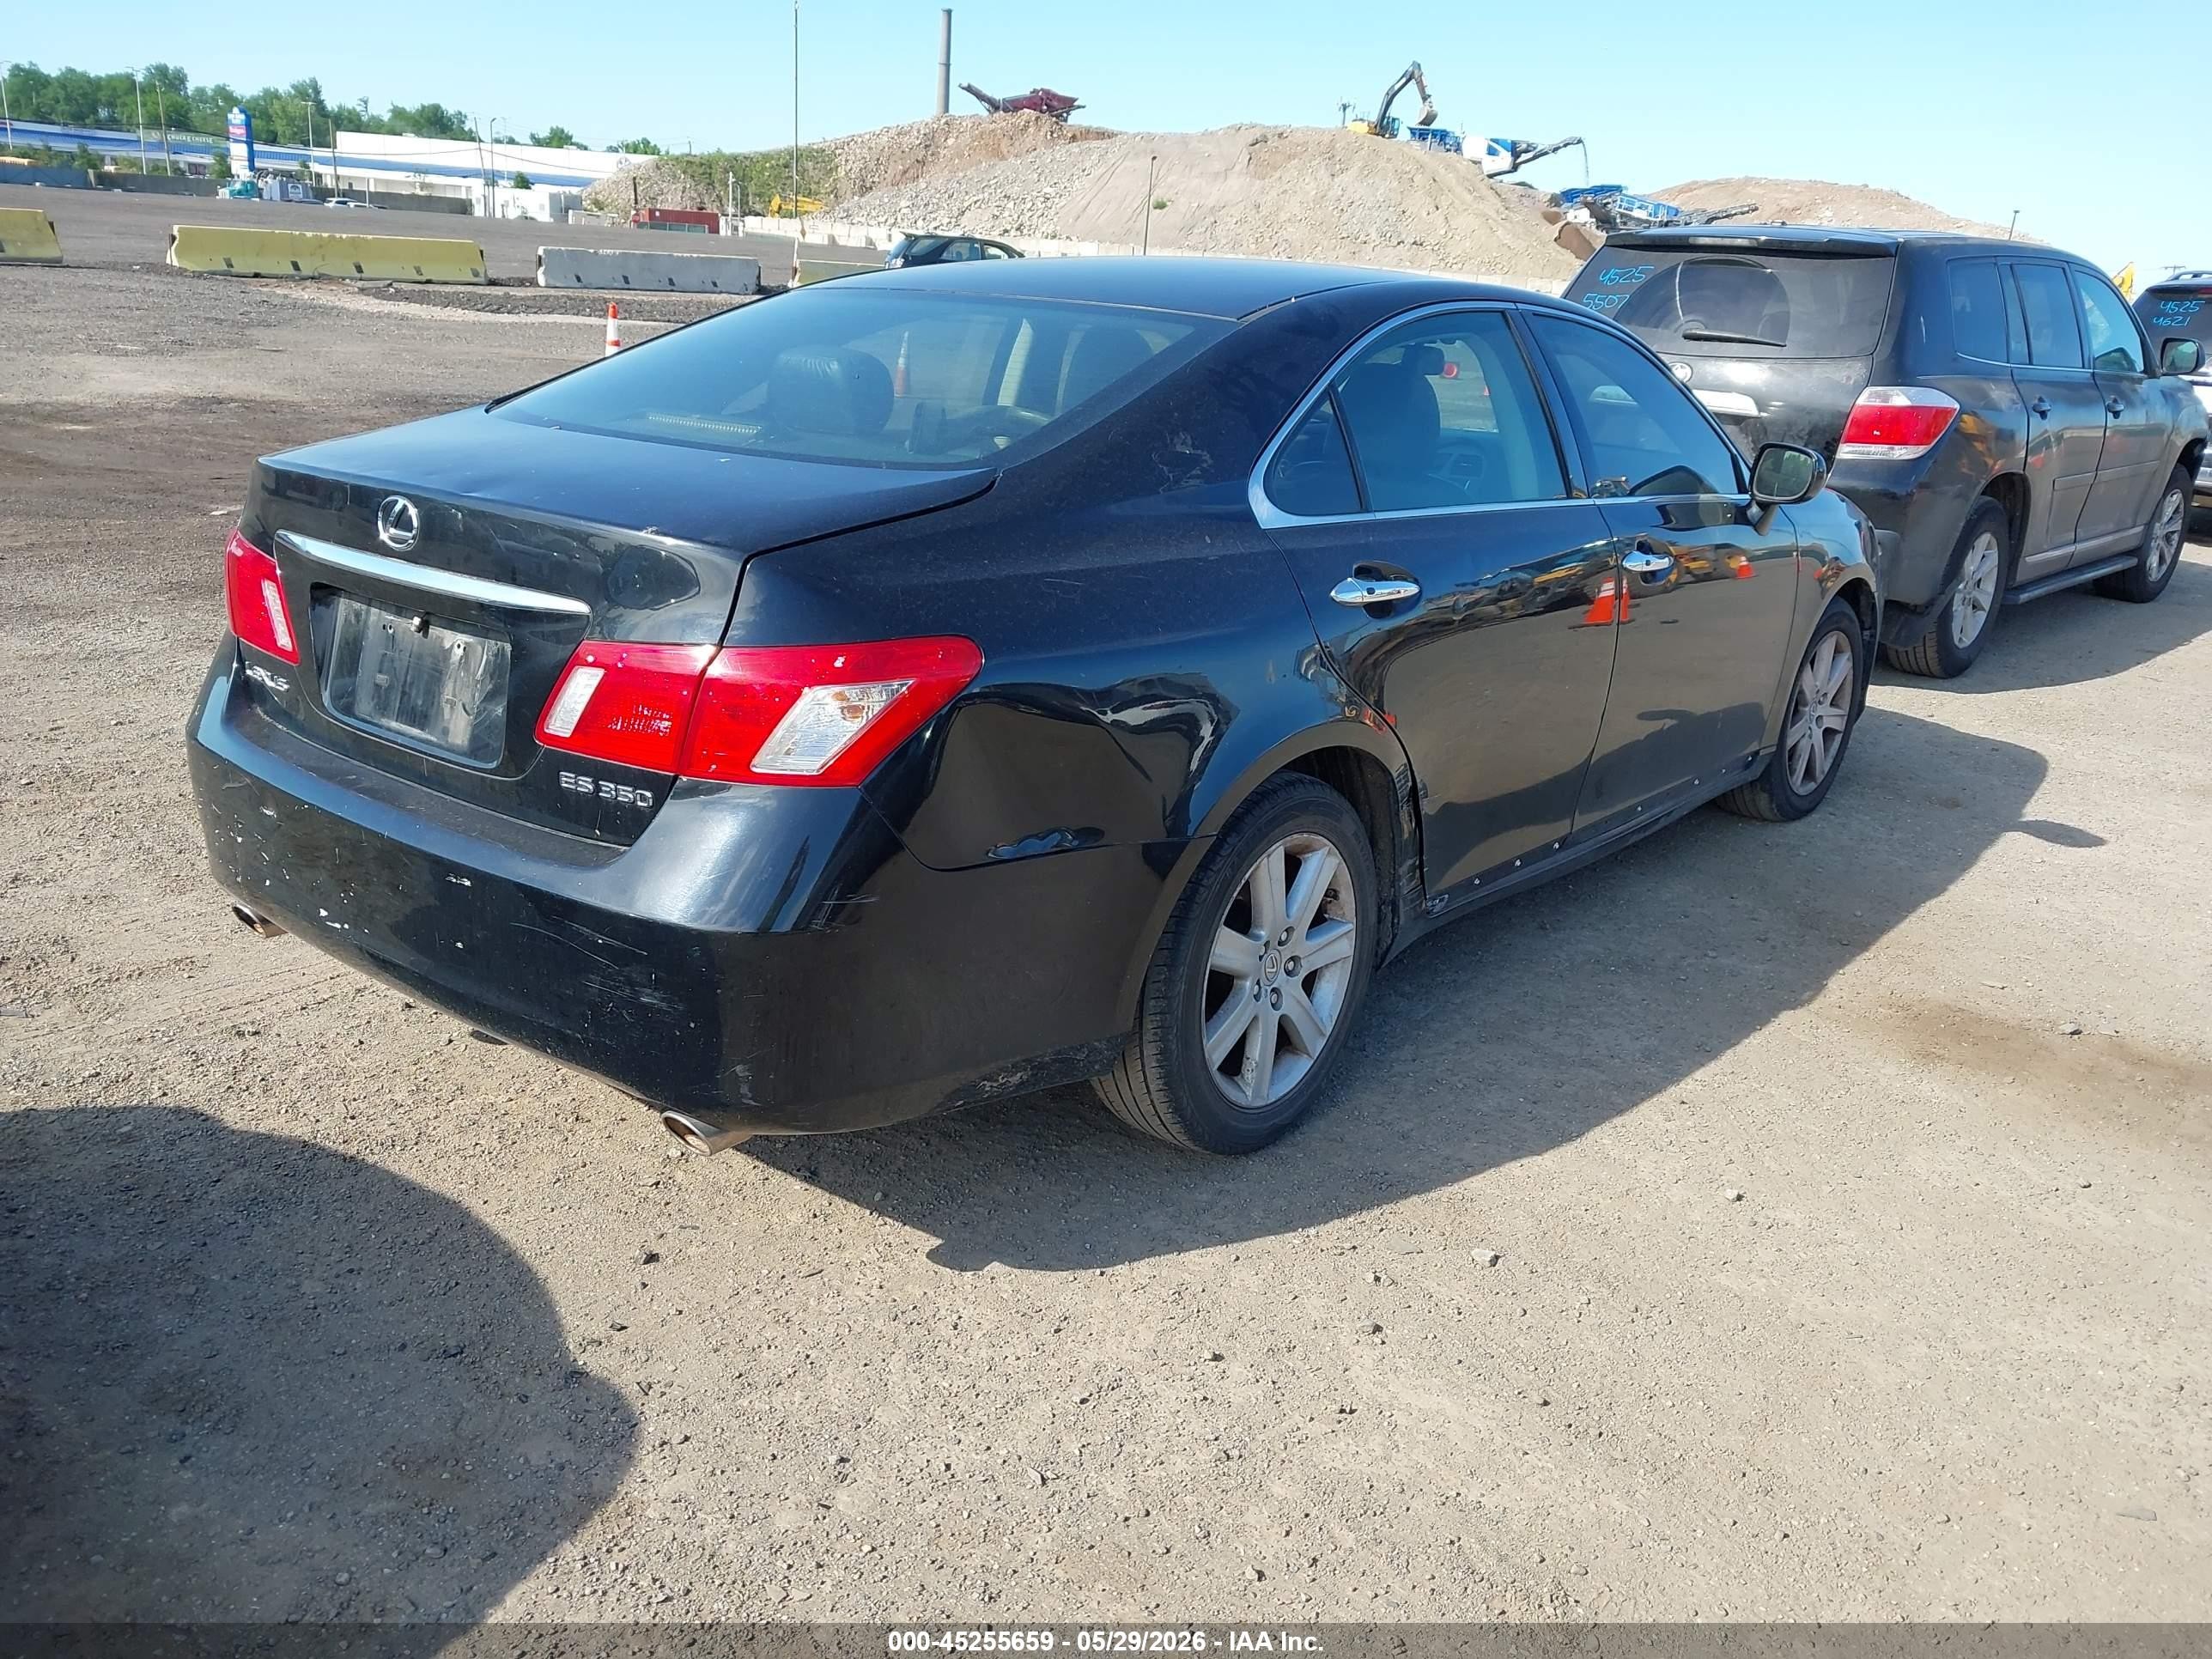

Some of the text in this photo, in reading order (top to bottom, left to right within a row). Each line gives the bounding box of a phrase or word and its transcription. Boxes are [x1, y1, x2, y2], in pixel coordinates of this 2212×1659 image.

[1599, 265, 1656, 286] 4525
[1583, 293, 1631, 310] 5507
[2160, 301, 2206, 313] 4525
[2153, 315, 2191, 326] 4621
[558, 771, 654, 809] ES 350
